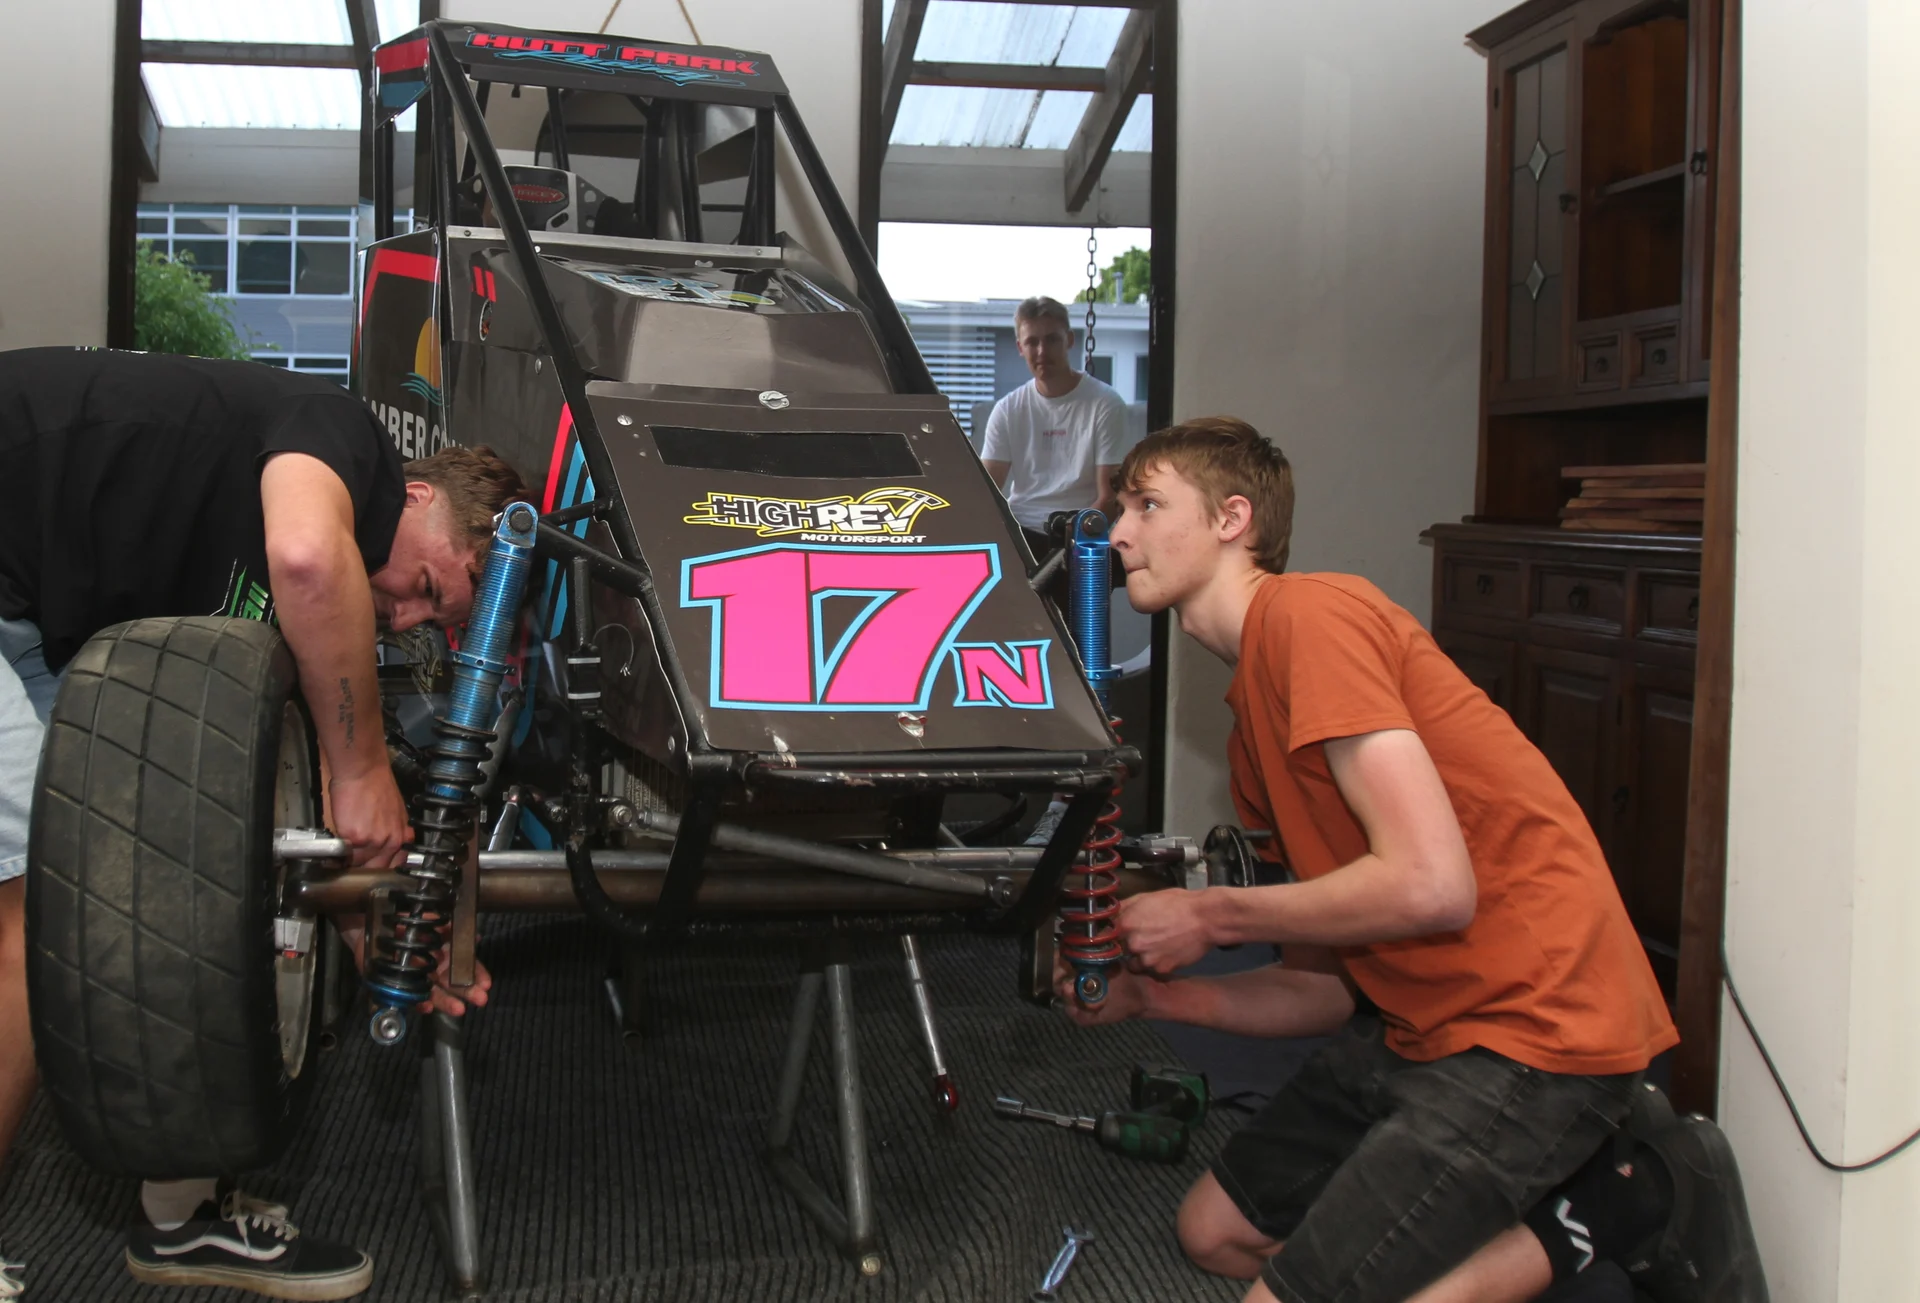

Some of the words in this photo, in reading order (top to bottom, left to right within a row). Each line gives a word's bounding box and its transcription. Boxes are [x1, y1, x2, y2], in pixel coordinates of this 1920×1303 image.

[467, 33, 609, 58] HUTT
[616, 46, 759, 76] PARK
[513, 188, 558, 199] IRKEY
[363, 396, 427, 460] BER
[800, 533, 927, 544] MOTORSPORT
